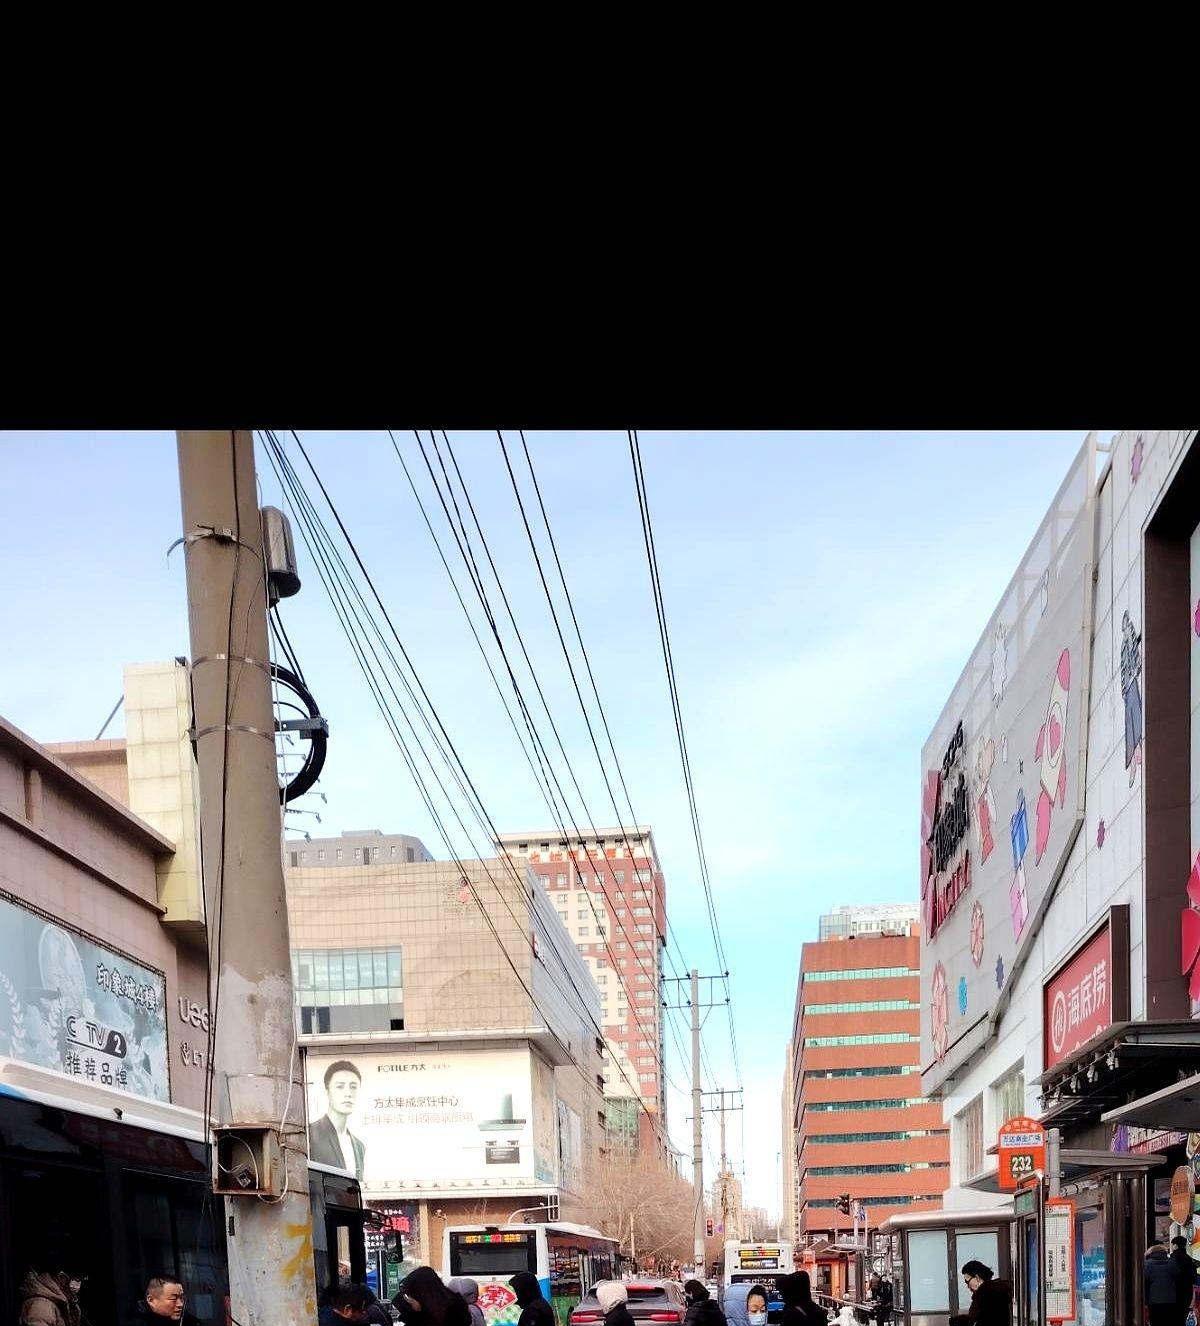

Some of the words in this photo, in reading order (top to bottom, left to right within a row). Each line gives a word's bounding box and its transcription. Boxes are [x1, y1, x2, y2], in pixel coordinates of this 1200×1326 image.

[1067, 957, 1107, 1031] 海底捞
[64, 1050, 128, 1090] 推荐品牌
[410, 1063, 427, 1071] 方太
[1011, 1156, 1032, 1172] 232
